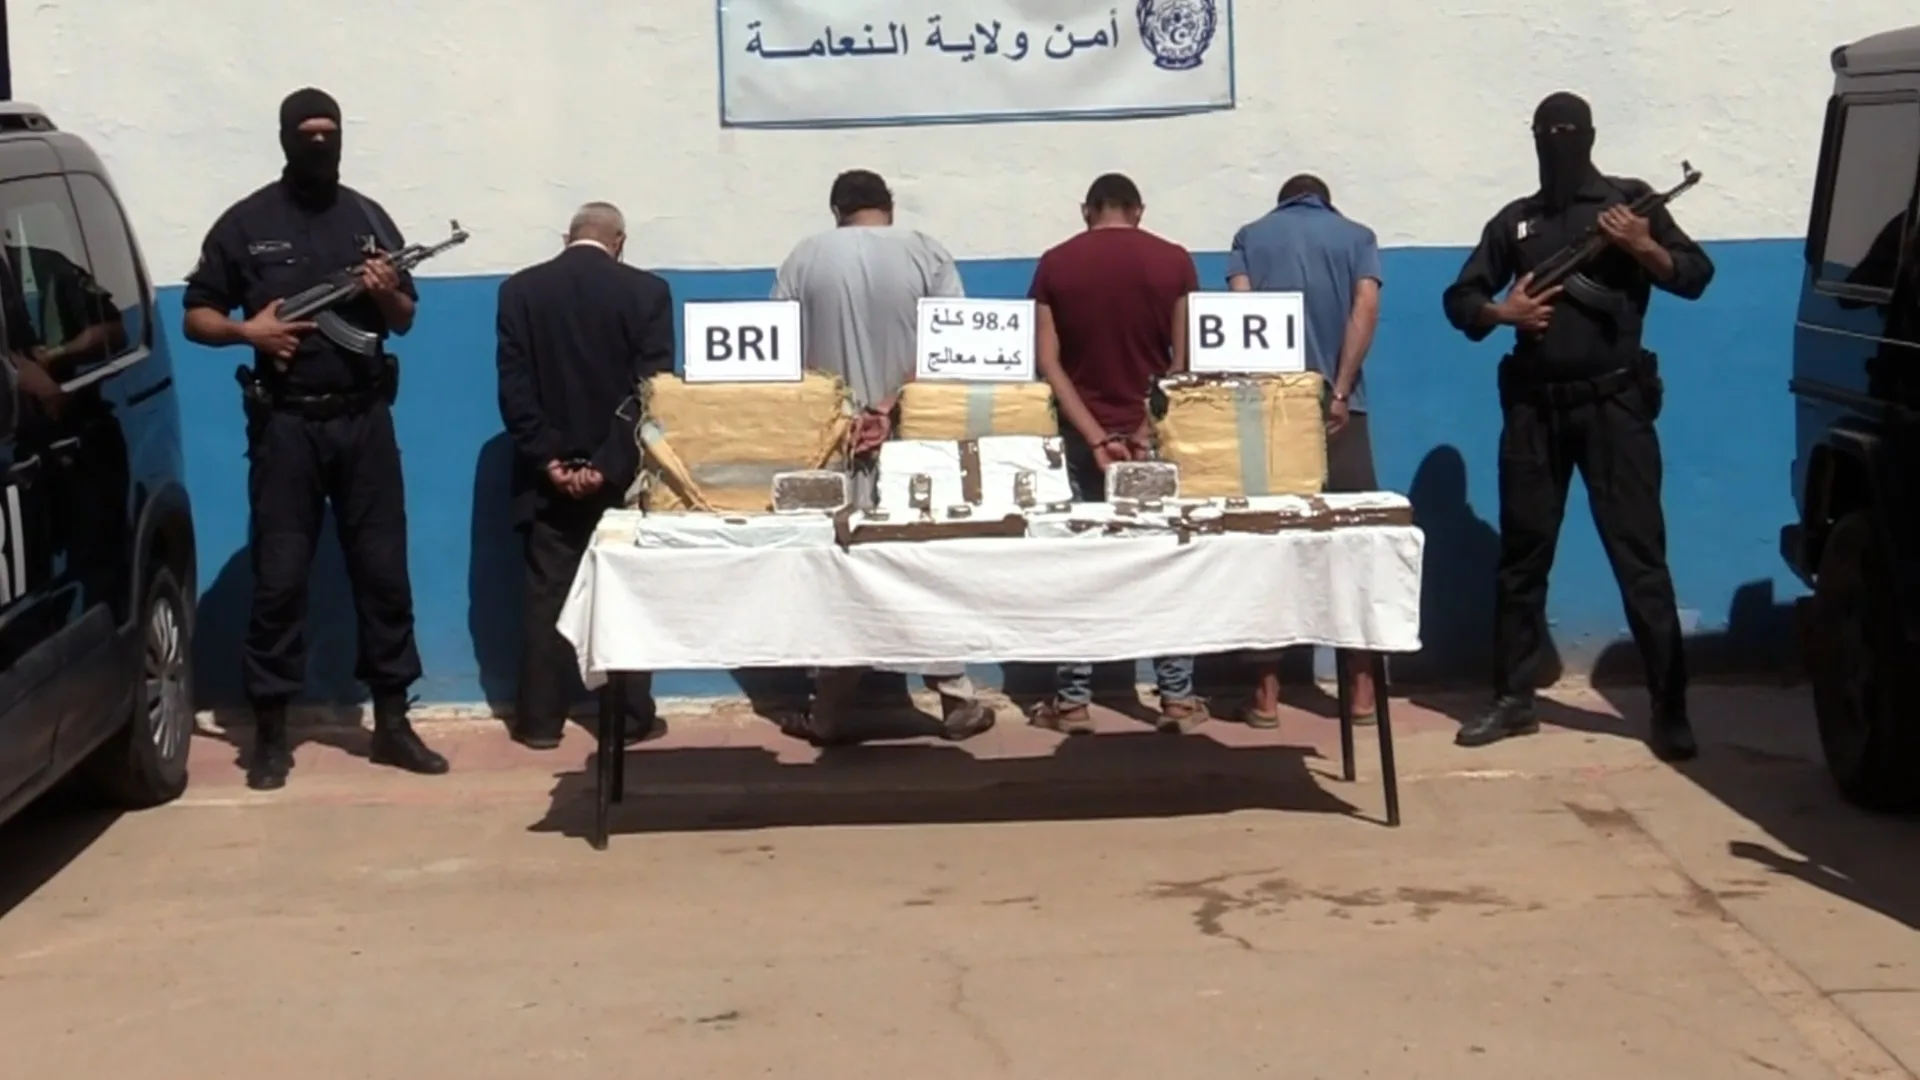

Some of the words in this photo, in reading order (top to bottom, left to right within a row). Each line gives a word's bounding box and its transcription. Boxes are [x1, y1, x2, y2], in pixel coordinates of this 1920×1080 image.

[925, 14, 1029, 62] ولاية
[1044, 9, 1120, 59] أمن
[930, 307, 964, 334] كلغ
[971, 311, 1020, 331] 98.4
[705, 326, 779, 361] BRI
[927, 346, 977, 372] معالج
[983, 347, 1022, 371] كيف
